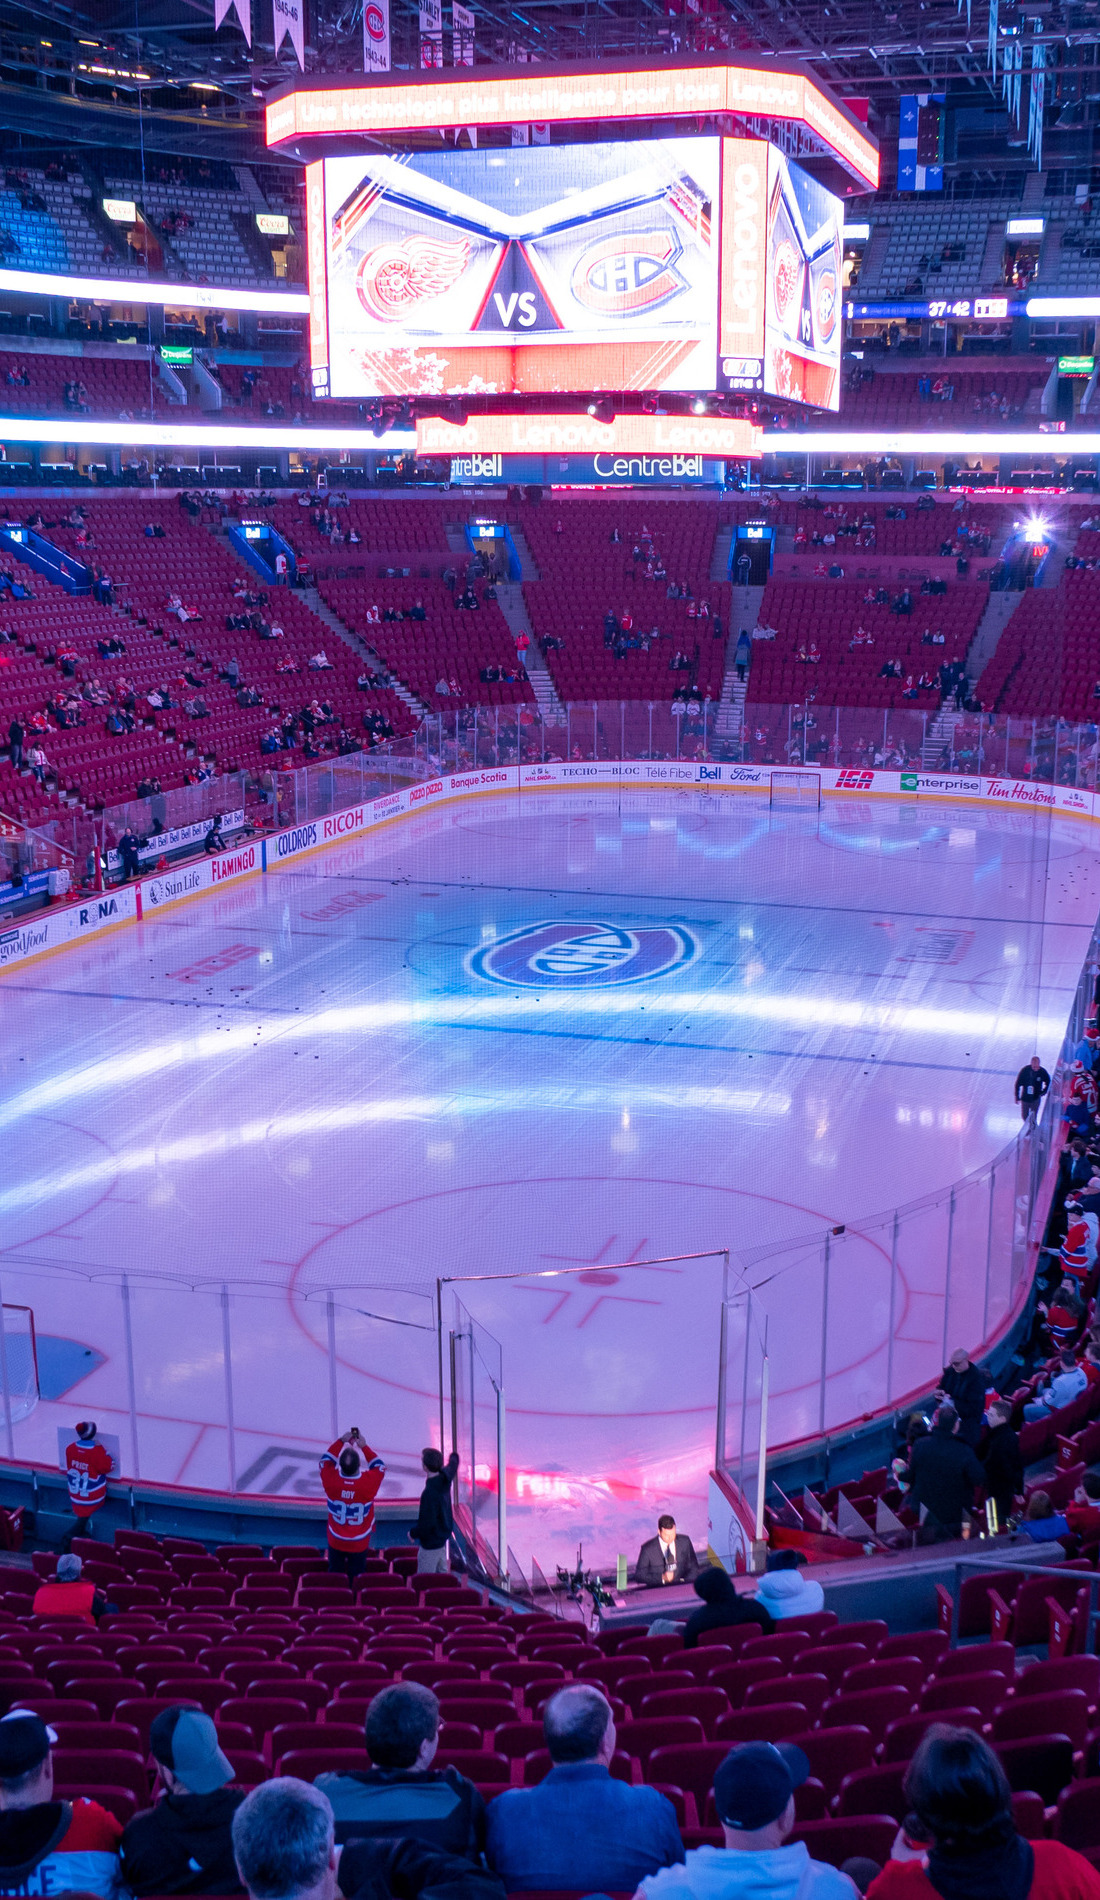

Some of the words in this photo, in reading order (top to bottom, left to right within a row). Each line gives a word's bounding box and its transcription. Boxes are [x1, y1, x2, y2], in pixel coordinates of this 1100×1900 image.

[275, 0, 299, 22] 1945-46
[365, 47, 387, 68] 1943-44
[301, 103, 337, 122] Une
[342, 95, 453, 120] technologie
[458, 93, 499, 118] plus
[622, 84, 670, 108] pour
[674, 82, 721, 101] tous
[732, 81, 799, 106] Lenovo
[260, 216, 285, 228] Coors
[726, 163, 759, 364] Lenovo
[493, 292, 538, 328] VS
[929, 301, 970, 317] 37:42
[421, 424, 478, 447] Lenovo
[512, 421, 616, 447] Lenovo
[655, 421, 735, 449] Lenovo
[245, 528, 261, 539] Bell
[479, 526, 495, 538] Bell
[747, 528, 763, 539] Bell
[450, 775, 480, 790] Banque
[480, 771, 508, 786] Scotia
[645, 766, 667, 779] Télé
[669, 767, 693, 779] Fibe
[699, 766, 722, 780] Bell
[730, 767, 762, 782] Ford
[835, 770, 875, 789] IGA
[904, 777, 979, 791] enterprise
[409, 787, 426, 806] pizza
[425, 781, 443, 800] pizza
[986, 780, 1009, 799] Tim
[1011, 783, 1056, 805] Hortons
[169, 832, 179, 844] Bell
[181, 828, 191, 840] Bell
[192, 825, 202, 836] Bell
[224, 814, 234, 826] Bell
[234, 810, 244, 822] Bell
[323, 809, 364, 838] RICOH
[278, 823, 317, 858] COLDROPS
[211, 846, 256, 883] FLAMINGO
[165, 877, 183, 898] Sun
[183, 871, 200, 891] Life
[0, 924, 49, 964] goodfood
[71, 1459, 89, 1471] PRICE
[67, 1468, 89, 1497] 31
[341, 1489, 355, 1499] ROY
[332, 1500, 365, 1525] 33
